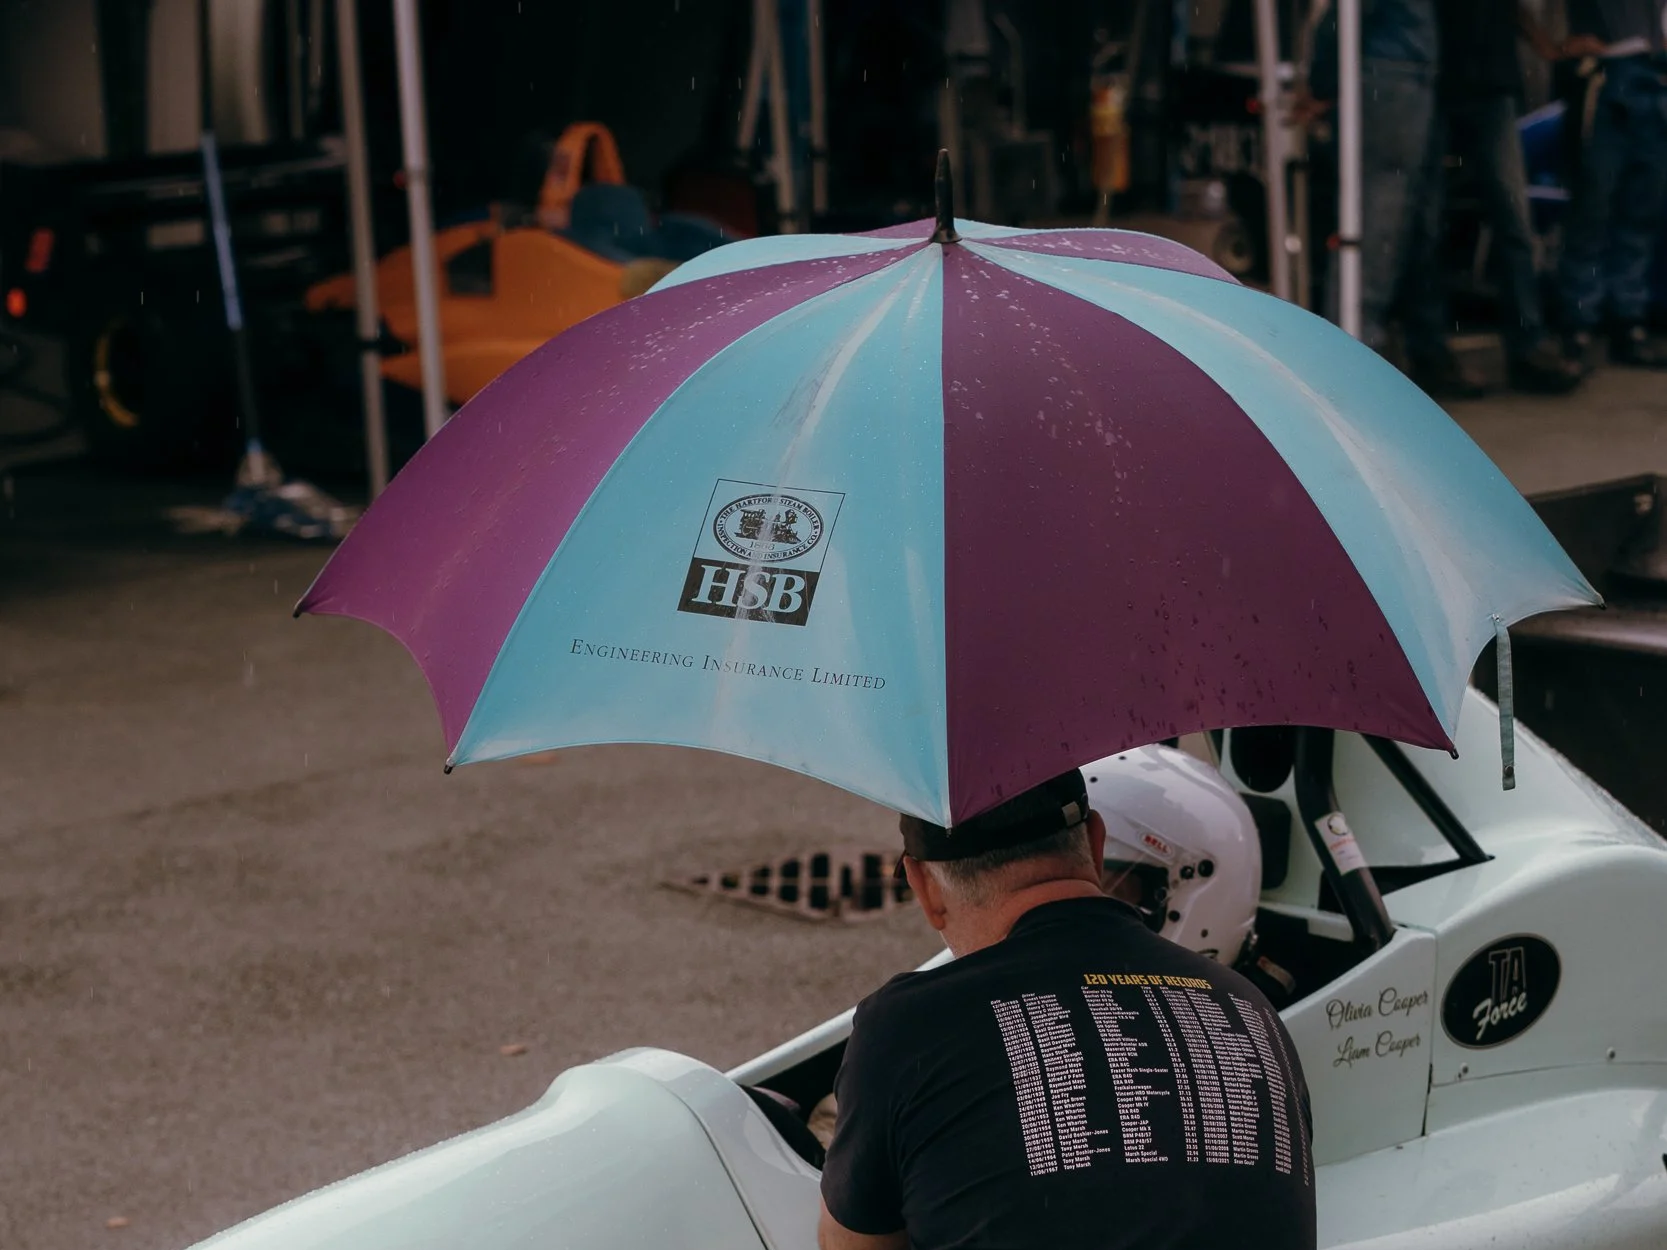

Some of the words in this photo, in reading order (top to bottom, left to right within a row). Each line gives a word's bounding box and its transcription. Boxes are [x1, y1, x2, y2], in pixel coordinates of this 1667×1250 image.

[721, 505, 735, 520] THE
[780, 498, 804, 510] STEAM
[802, 506, 820, 531] BOILER
[717, 523, 746, 555] INSPECTION
[764, 545, 807, 560] INSURANCE
[692, 564, 806, 613] HSB
[1145, 835, 1168, 853] BELL
[1083, 974, 1108, 985] 120
[1108, 974, 1149, 985] YEARS
[1148, 975, 1163, 985] OF
[1163, 976, 1212, 990] RECORDS
[1489, 946, 1527, 1004] TA
[1326, 999, 1373, 1029] Olivia
[1378, 987, 1428, 1017] Cooper
[1332, 1036, 1370, 1068] Liam
[1375, 1030, 1421, 1058] Cooper
